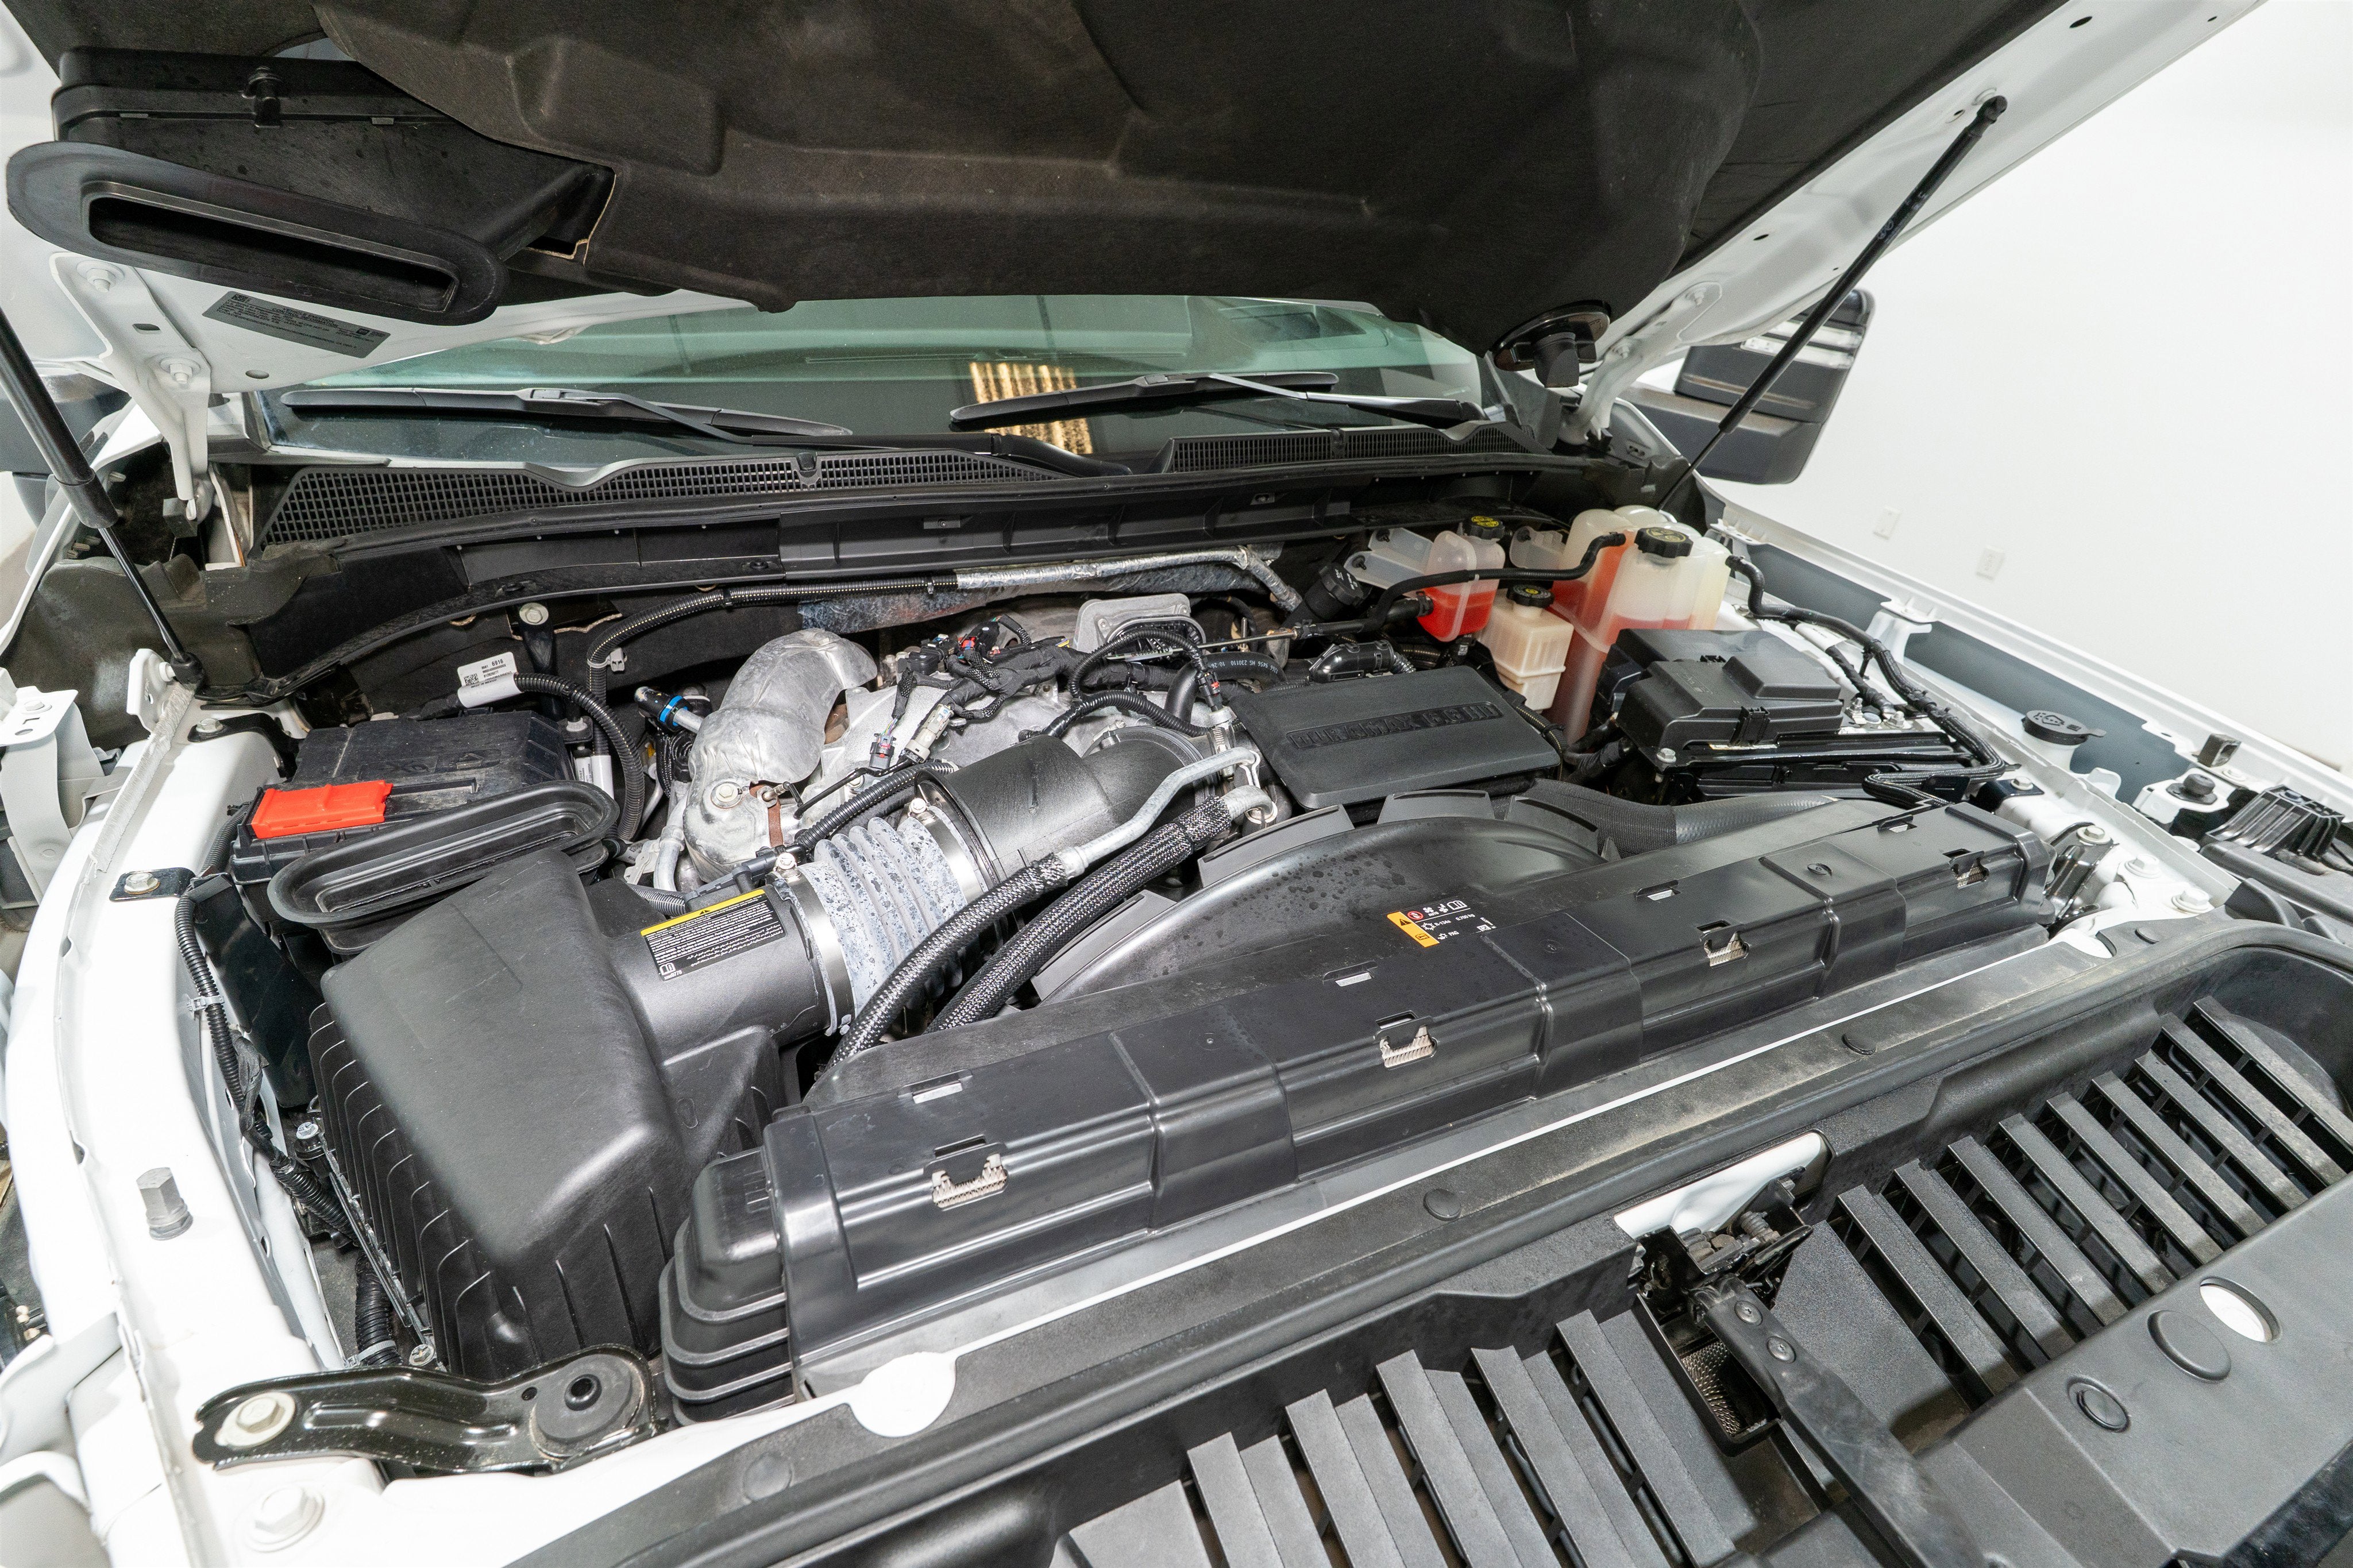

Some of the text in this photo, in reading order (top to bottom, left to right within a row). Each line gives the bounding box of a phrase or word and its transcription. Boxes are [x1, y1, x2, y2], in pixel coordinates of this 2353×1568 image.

[271, 307, 299, 317] CONTROL
[300, 315, 339, 327] INFORMATION
[281, 307, 335, 323] VEHICLE EMISSION
[492, 659, 504, 667] 6916
[1290, 715, 1421, 749] DURAMAX
[1463, 704, 1499, 721] HD
